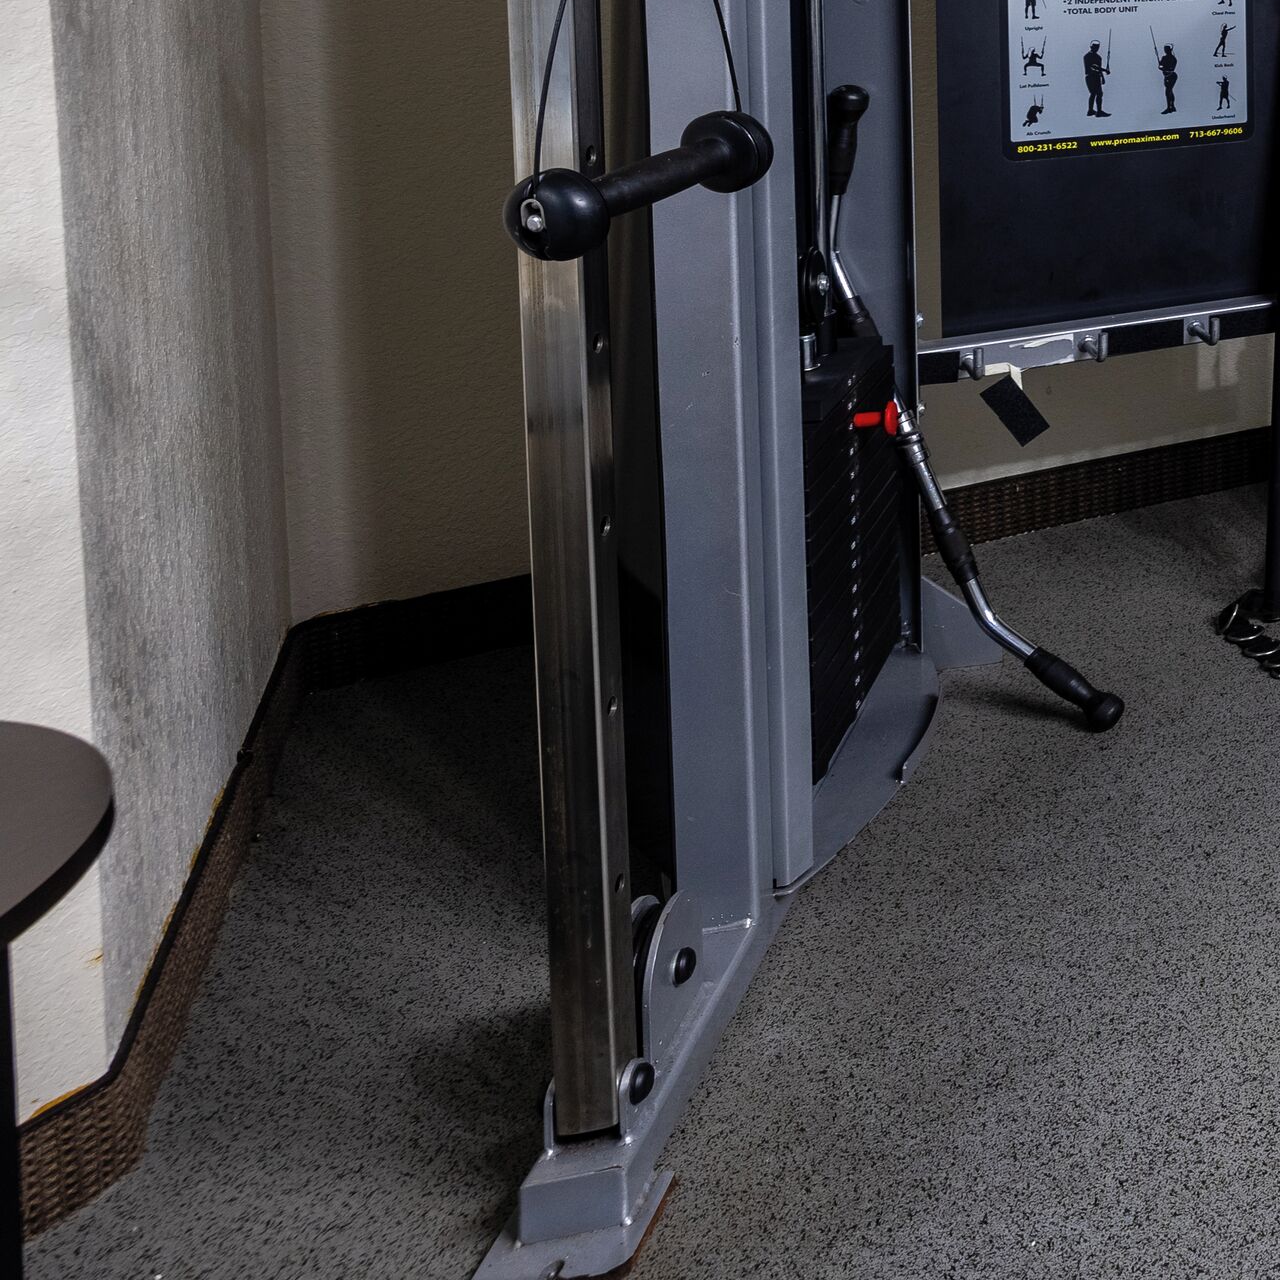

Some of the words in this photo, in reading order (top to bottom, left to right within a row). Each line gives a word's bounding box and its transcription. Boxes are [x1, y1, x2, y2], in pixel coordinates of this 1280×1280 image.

[1094, 6, 1117, 14] BODY
[1017, 141, 1078, 153] 800-231-6522
[1090, 133, 1180, 147] www.promaxima.com
[1189, 126, 1243, 139] 713-667-9606
